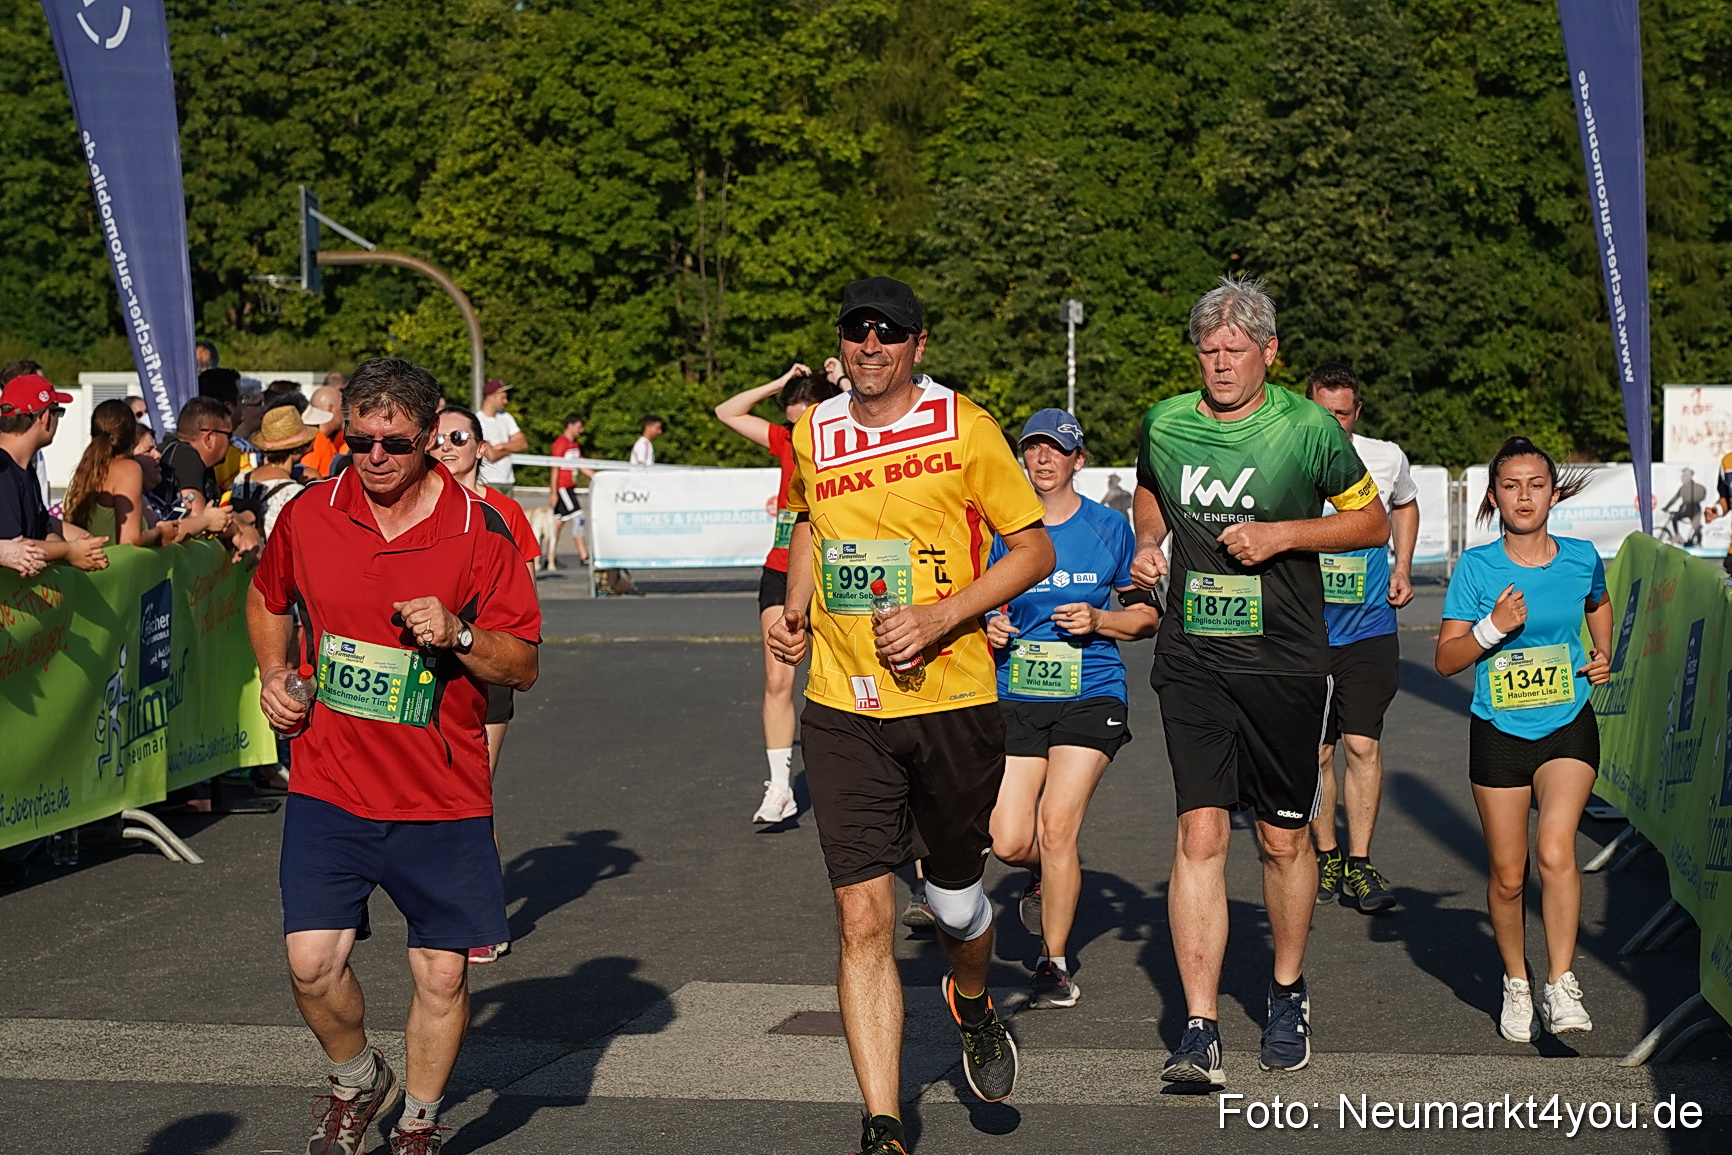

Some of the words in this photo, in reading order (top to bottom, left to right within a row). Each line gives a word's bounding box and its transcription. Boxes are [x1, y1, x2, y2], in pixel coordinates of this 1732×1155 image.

[815, 469, 876, 502] MAX
[884, 451, 962, 484] BÖGL
[1203, 512, 1256, 523] ENERGIE
[838, 565, 886, 590] 992
[897, 569, 907, 604] 2022
[1076, 574, 1095, 582] BAU
[1356, 575, 1364, 598] 2022
[859, 591, 874, 599] Seb
[1193, 594, 1248, 616] 1872
[1191, 615, 1222, 625] Englisch
[1223, 618, 1250, 627] Jürgen
[1249, 600, 1258, 628] 2022
[319, 664, 328, 690] RUN
[328, 661, 390, 696] 1635
[1025, 660, 1063, 679] 732
[1070, 664, 1078, 690] 2022
[1503, 666, 1558, 690] 1347
[1560, 667, 1570, 695] 2022
[1026, 679, 1042, 687] Wild
[1042, 679, 1062, 687] Maria
[1494, 674, 1504, 704] WALK
[1507, 690, 1540, 699] Haubner
[1541, 688, 1558, 696] Lisa
[371, 696, 388, 707] Tim
[387, 678, 401, 712] 2022
[1276, 809, 1304, 819] adidas
